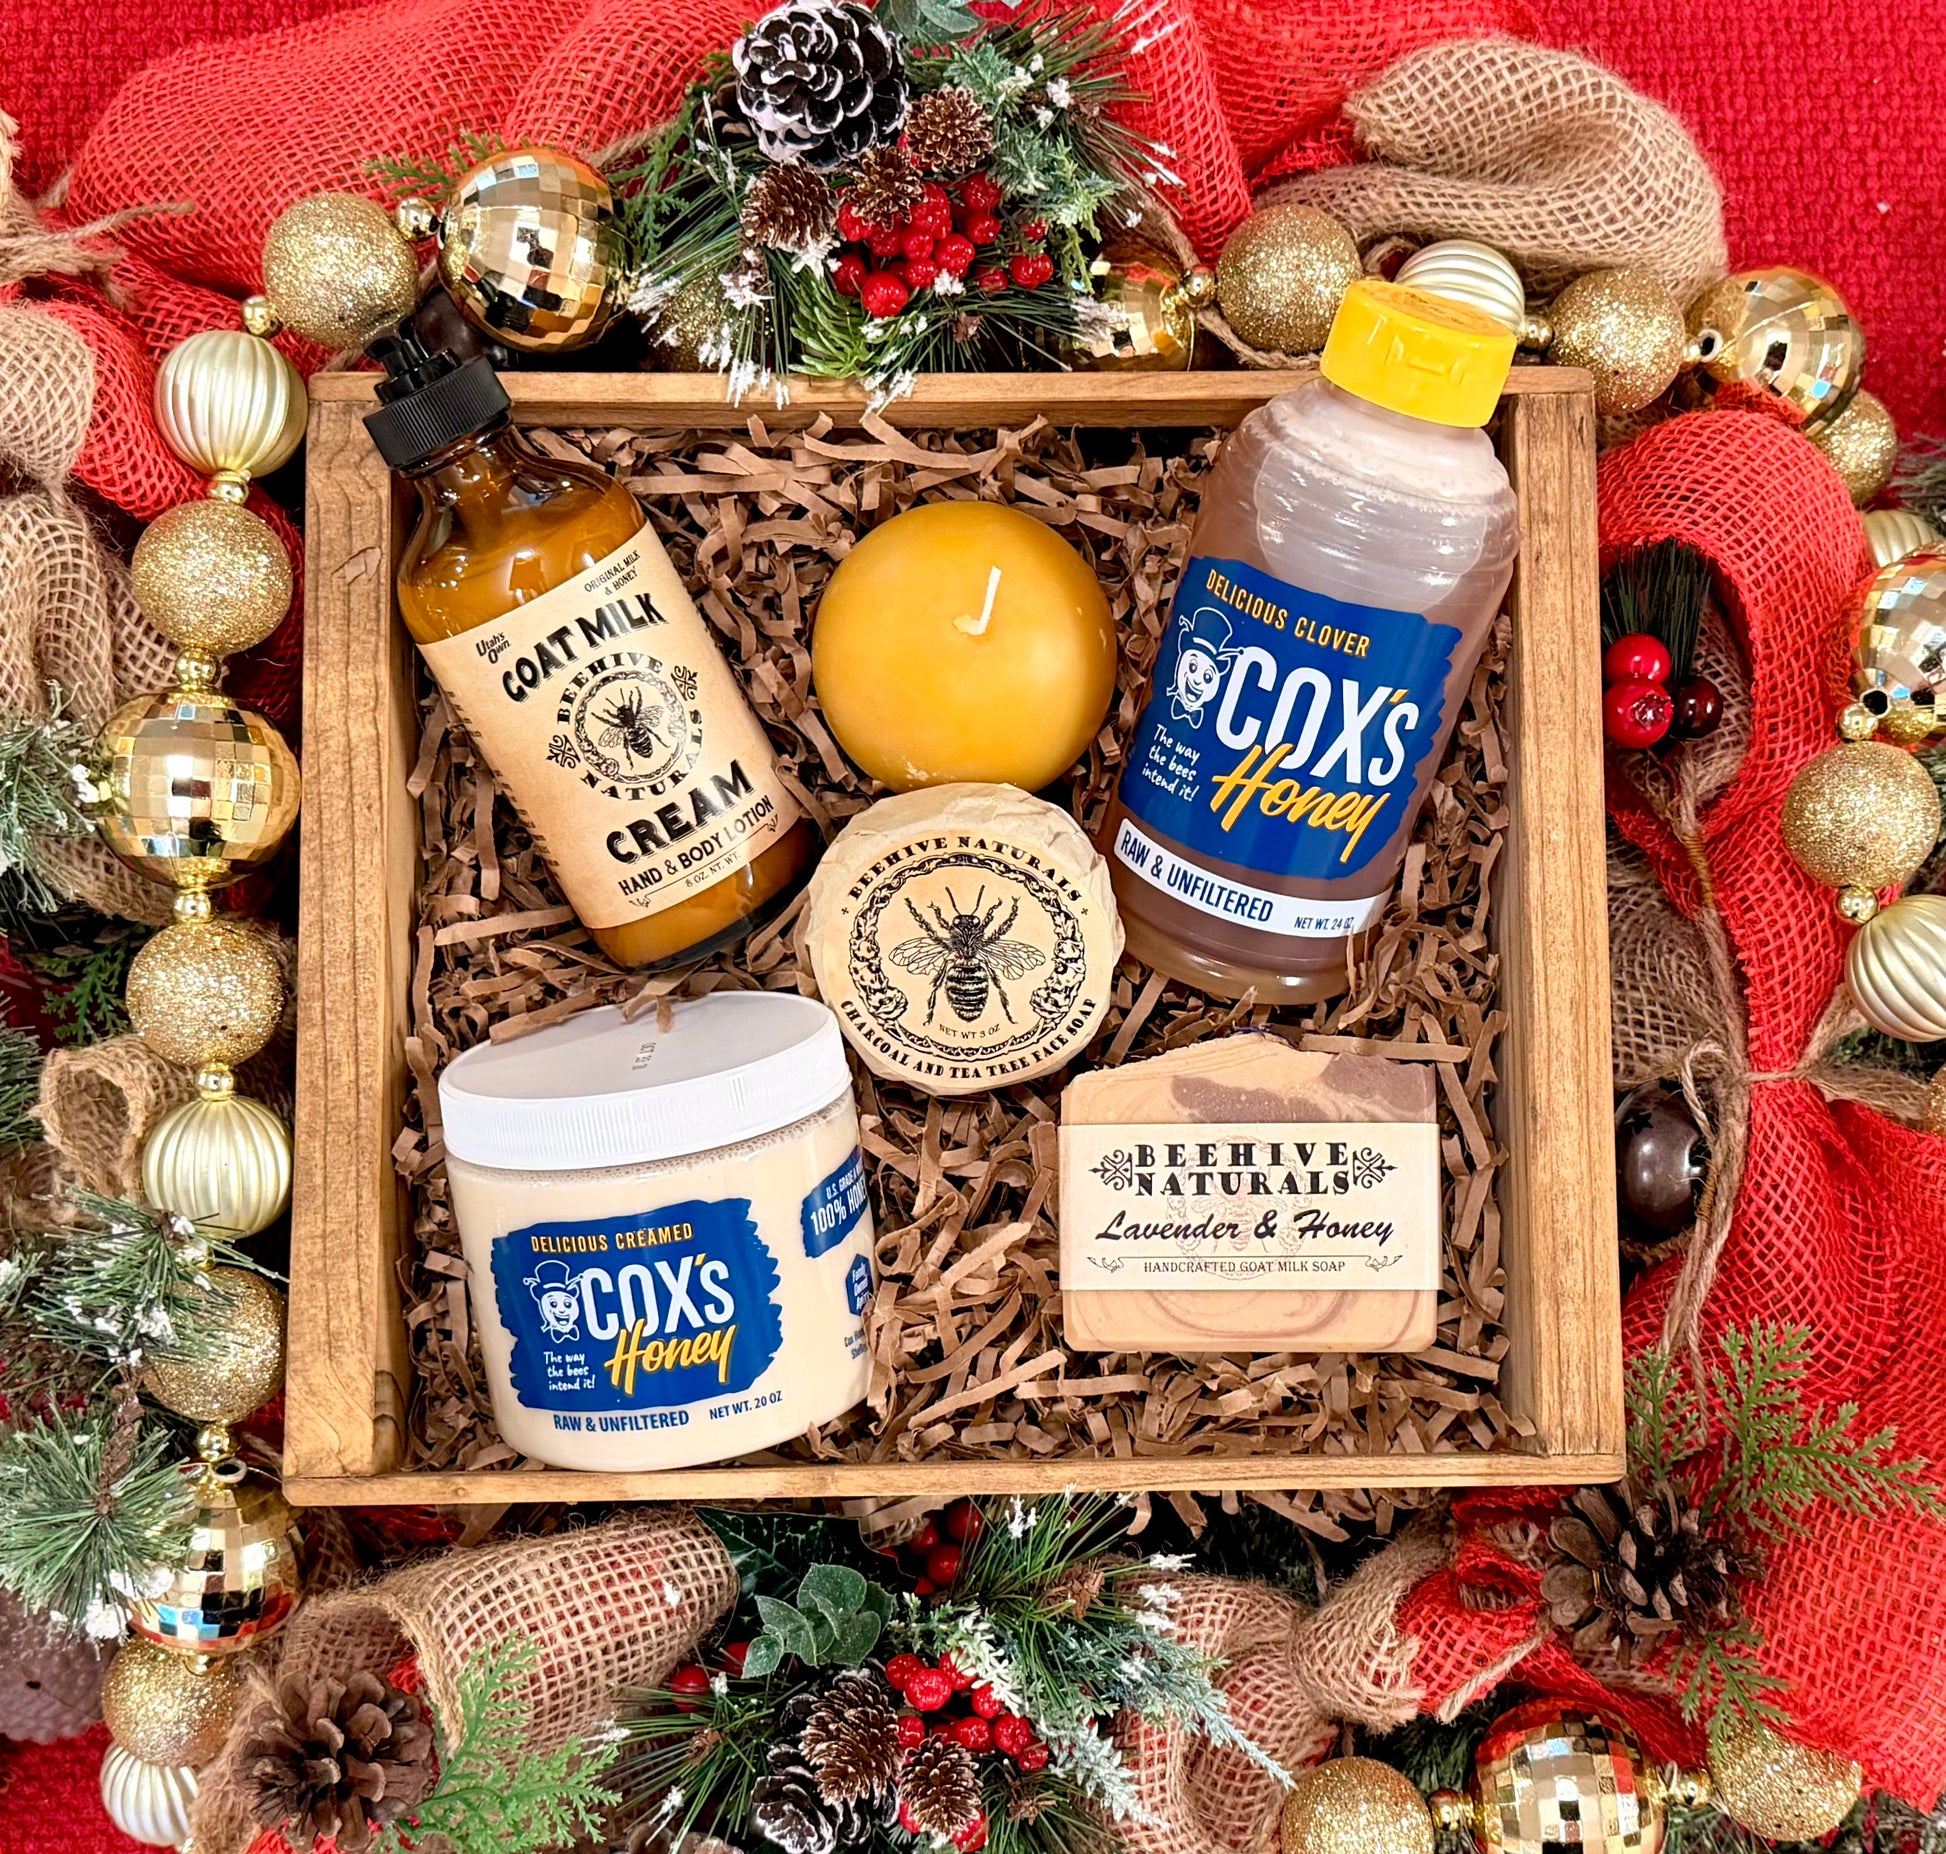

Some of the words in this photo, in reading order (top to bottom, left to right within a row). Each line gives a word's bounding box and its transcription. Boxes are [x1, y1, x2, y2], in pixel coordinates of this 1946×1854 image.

[584, 565, 625, 593] ORIGINAL
[623, 549, 641, 569] MILK
[605, 586, 612, 596] &
[613, 565, 639, 591] HONEY
[1206, 568, 1289, 630] DELICIOUS
[1294, 617, 1371, 658] CLOVER
[476, 631, 506, 657] Utah's
[487, 638, 511, 664] Own
[502, 625, 580, 703] GOAT
[575, 592, 669, 650] MILK
[557, 652, 664, 724] BEEHIVE
[580, 710, 703, 801] NATURALS
[1153, 724, 1173, 748] The
[1174, 741, 1200, 763] way
[1149, 745, 1167, 767] the
[1168, 755, 1197, 781] bees
[1142, 763, 1178, 794] intend
[1179, 781, 1199, 802] it!
[606, 759, 758, 865] CREAM
[1209, 743, 1390, 863] Honey
[618, 868, 663, 896] HAND
[665, 859, 677, 876] &
[677, 832, 723, 871] BODY
[722, 795, 774, 842] LOTION
[847, 836, 948, 901] BEEHIVE
[956, 836, 1084, 901] NATURALS
[1120, 829, 1149, 868] RAW
[1150, 855, 1163, 880] &
[1167, 865, 1274, 923] UNFILTERED
[1294, 916, 1314, 929] NET
[1331, 918, 1343, 930] 24
[840, 999, 909, 1066] CHARCOAL
[912, 1060, 944, 1078] AND
[949, 1066, 982, 1079] TEA
[986, 1058, 1031, 1077] TREE
[1032, 1035, 1069, 1063] FACE
[1066, 998, 1098, 1037] SOAP
[939, 1023, 957, 1038] NET
[960, 1029, 978, 1039] WT
[979, 1028, 986, 1039] 3
[987, 1023, 1001, 1037] OZ
[1134, 1141, 1348, 1168] BEEHIVE
[1135, 1171, 1350, 1196] NATURALS
[810, 1196, 847, 1236] 100%
[1095, 1210, 1242, 1241] Lavender
[1253, 1209, 1277, 1239] &
[1293, 1209, 1394, 1247] Honey
[531, 1234, 609, 1254] DELICIOUS
[615, 1222, 695, 1250] CREAMED
[1143, 1260, 1236, 1273] HANDCRAFTED
[1239, 1260, 1276, 1273] GOAT
[1277, 1260, 1309, 1273] MILK
[1312, 1260, 1346, 1273] SOAP
[543, 1351, 563, 1365] The
[564, 1352, 585, 1367] way
[547, 1365, 565, 1378] the
[566, 1363, 590, 1377] bees
[604, 1318, 737, 1397] Honey
[548, 1376, 581, 1391] intend
[582, 1374, 596, 1390] it!
[553, 1413, 584, 1431] RAW
[585, 1416, 597, 1433] &
[599, 1409, 690, 1432] UNFILTERED
[709, 1405, 731, 1421] NET
[731, 1400, 753, 1417] WT.
[754, 1395, 768, 1410] 20
[768, 1390, 784, 1406] OZ
